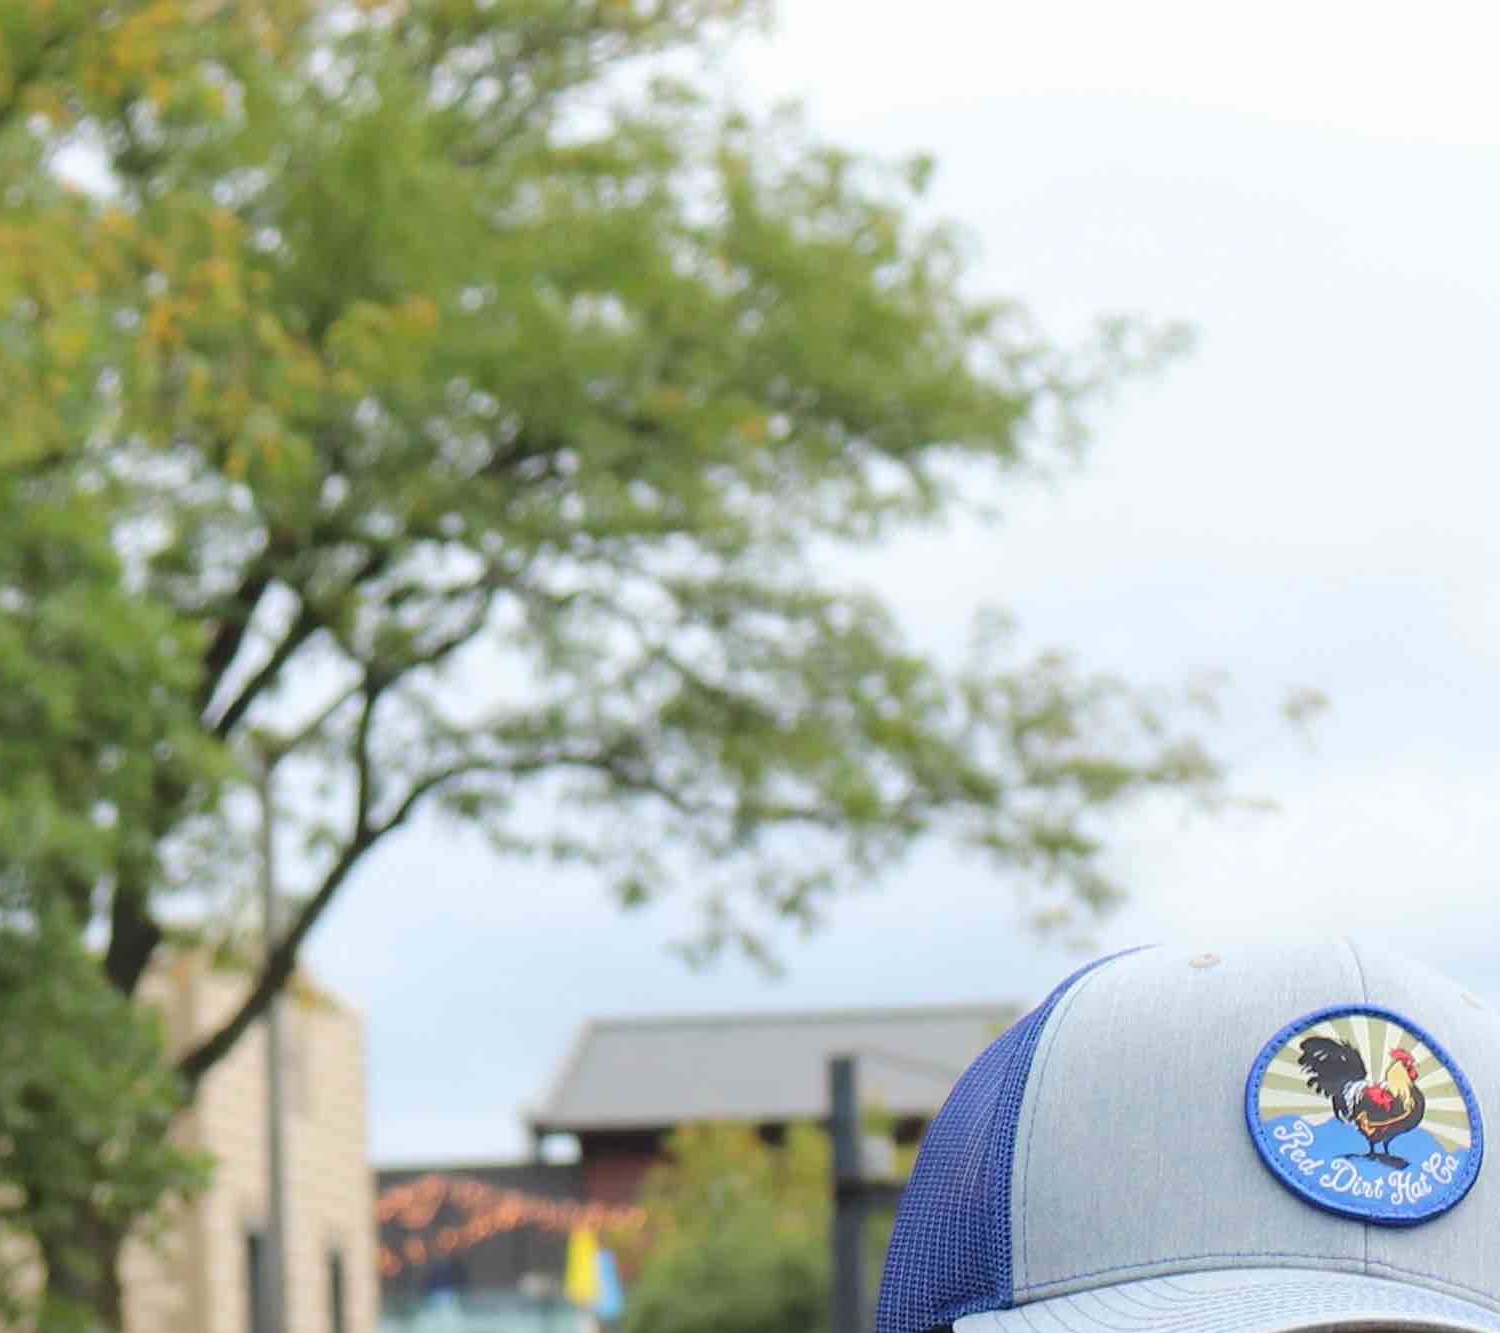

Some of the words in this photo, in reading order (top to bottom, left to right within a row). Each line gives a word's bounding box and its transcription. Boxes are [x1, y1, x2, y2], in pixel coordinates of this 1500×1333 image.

[1273, 1119, 1324, 1176] Red
[1319, 1157, 1384, 1200] Dirt
[1388, 1171, 1433, 1205] Hat
